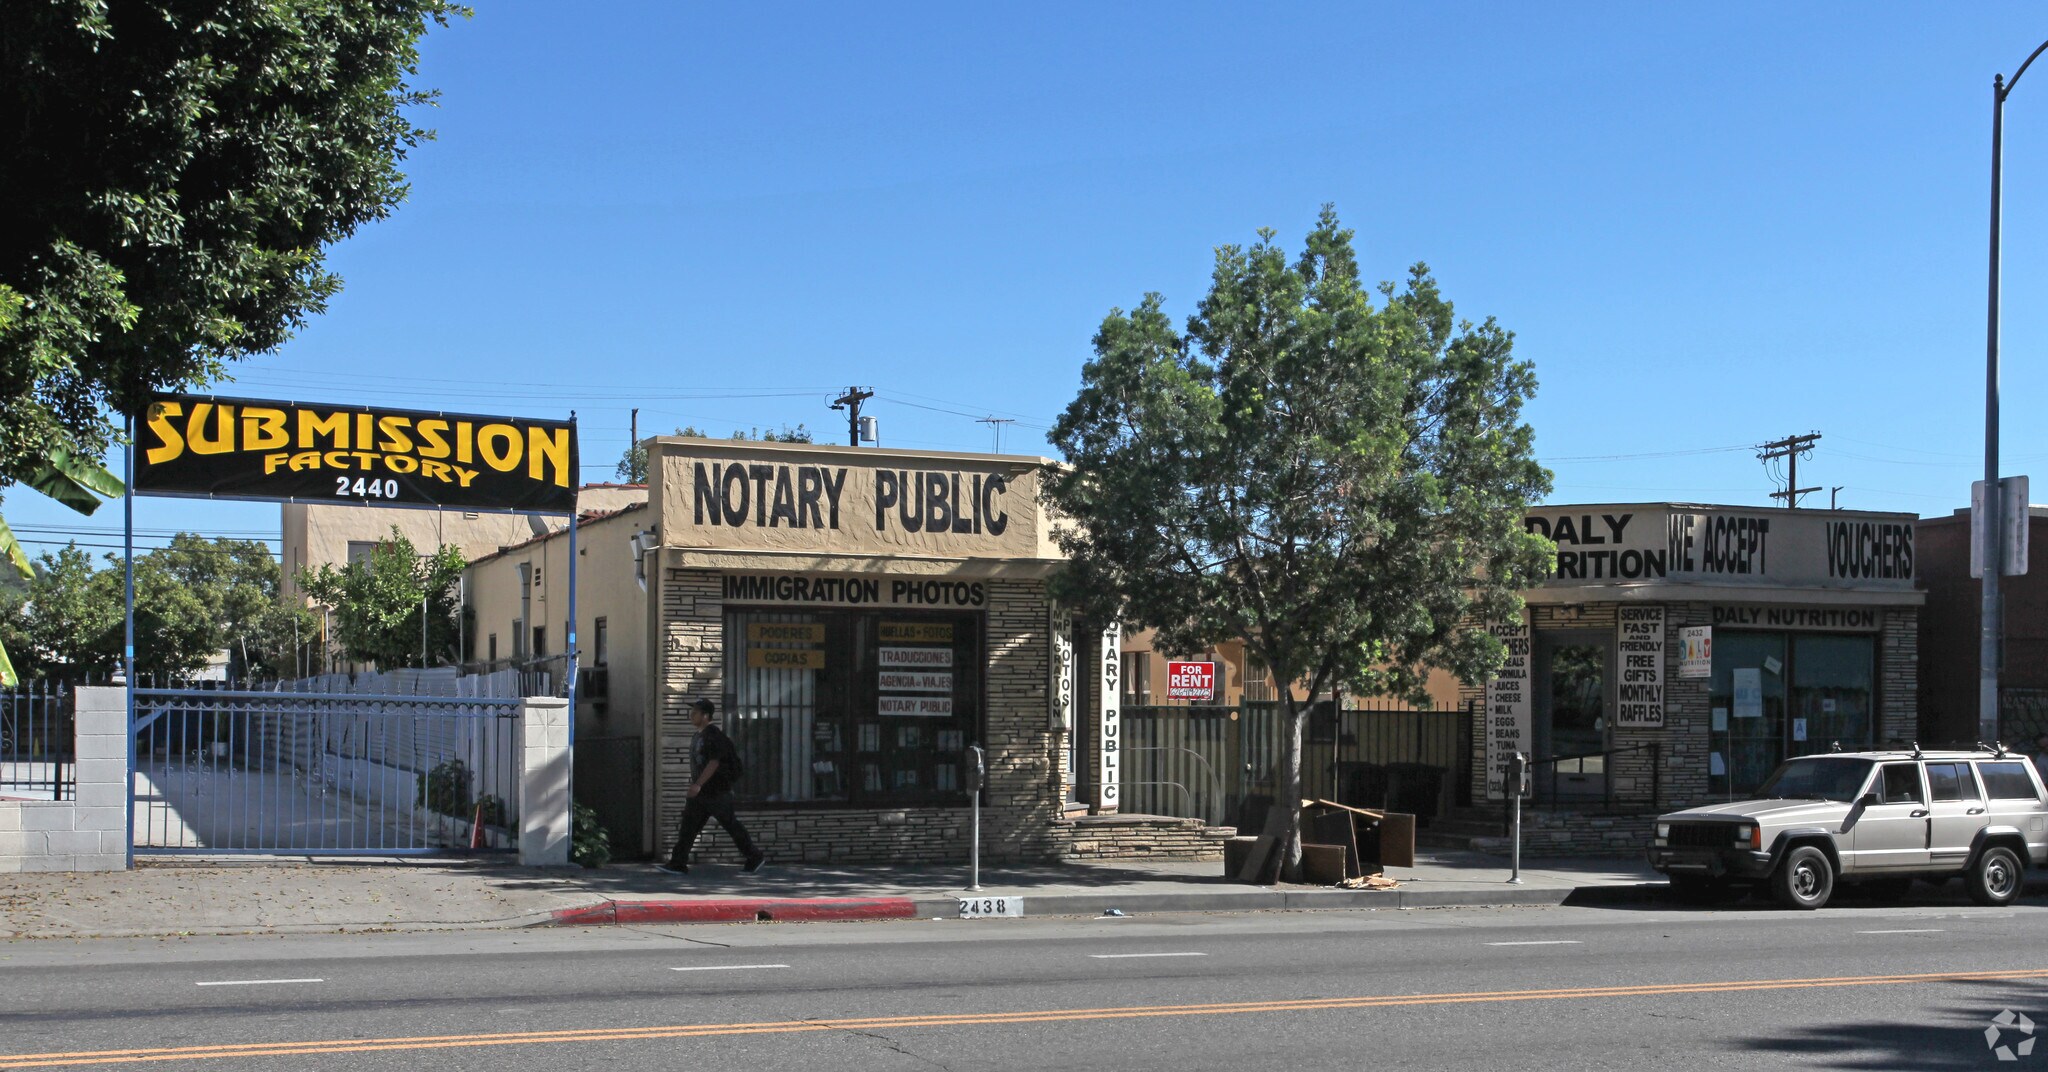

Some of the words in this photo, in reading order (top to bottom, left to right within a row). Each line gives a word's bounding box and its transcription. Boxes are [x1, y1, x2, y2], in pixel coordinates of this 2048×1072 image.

[146, 401, 569, 488] SUBMISSION
[264, 451, 479, 488] FACTORY
[336, 476, 398, 499] 2440
[694, 462, 847, 530] NOTARY
[875, 469, 1008, 536] PUBLIC
[1524, 513, 1633, 544] DALY
[1668, 513, 1694, 572] WE
[1703, 515, 1769, 575] ACCEPT
[1826, 521, 1912, 579] VOUCHERS
[1545, 549, 1666, 580] RITION
[722, 575, 879, 603] IMMIGRATION
[892, 580, 985, 606] PHOTOS
[1621, 608, 1662, 620] SERVICE
[1712, 606, 1761, 625] DALY
[1767, 609, 1875, 627] NUTRITION
[760, 626, 813, 639] PODERES
[923, 626, 952, 639] FOTOS
[1489, 625, 1528, 636] ACCEPT
[1623, 623, 1660, 634] FAST
[1620, 642, 1662, 652] FRIENDLY
[764, 652, 807, 665] COPIAS
[881, 651, 950, 663] TRADUCCIONES
[1105, 619, 1118, 691] OTARY
[1627, 655, 1655, 668] FREE
[1053, 609, 1062, 718] MMIGRATION
[1062, 618, 1071, 707] PHOTOS
[1503, 657, 1525, 668] REALS
[1181, 666, 1202, 674] FOR
[1624, 669, 1657, 682] GIFTS
[880, 675, 915, 687] AGENCIA
[923, 676, 951, 688] VIAJES
[1171, 675, 1211, 687] RENT
[1495, 681, 1520, 691] JUICES
[1495, 693, 1521, 703] CHEESE
[1620, 684, 1662, 702] MONTHLY
[880, 700, 916, 713] NOTARY
[920, 700, 950, 713] PUBLIC
[1495, 705, 1512, 715] MILK
[1620, 704, 1662, 722] RAFFLES
[1495, 717, 1515, 727] EGGS
[1495, 729, 1520, 739] BEANS
[1496, 741, 1516, 750] TUNA
[1105, 709, 1117, 799] PUBLIC
[960, 900, 1006, 914] 2438
